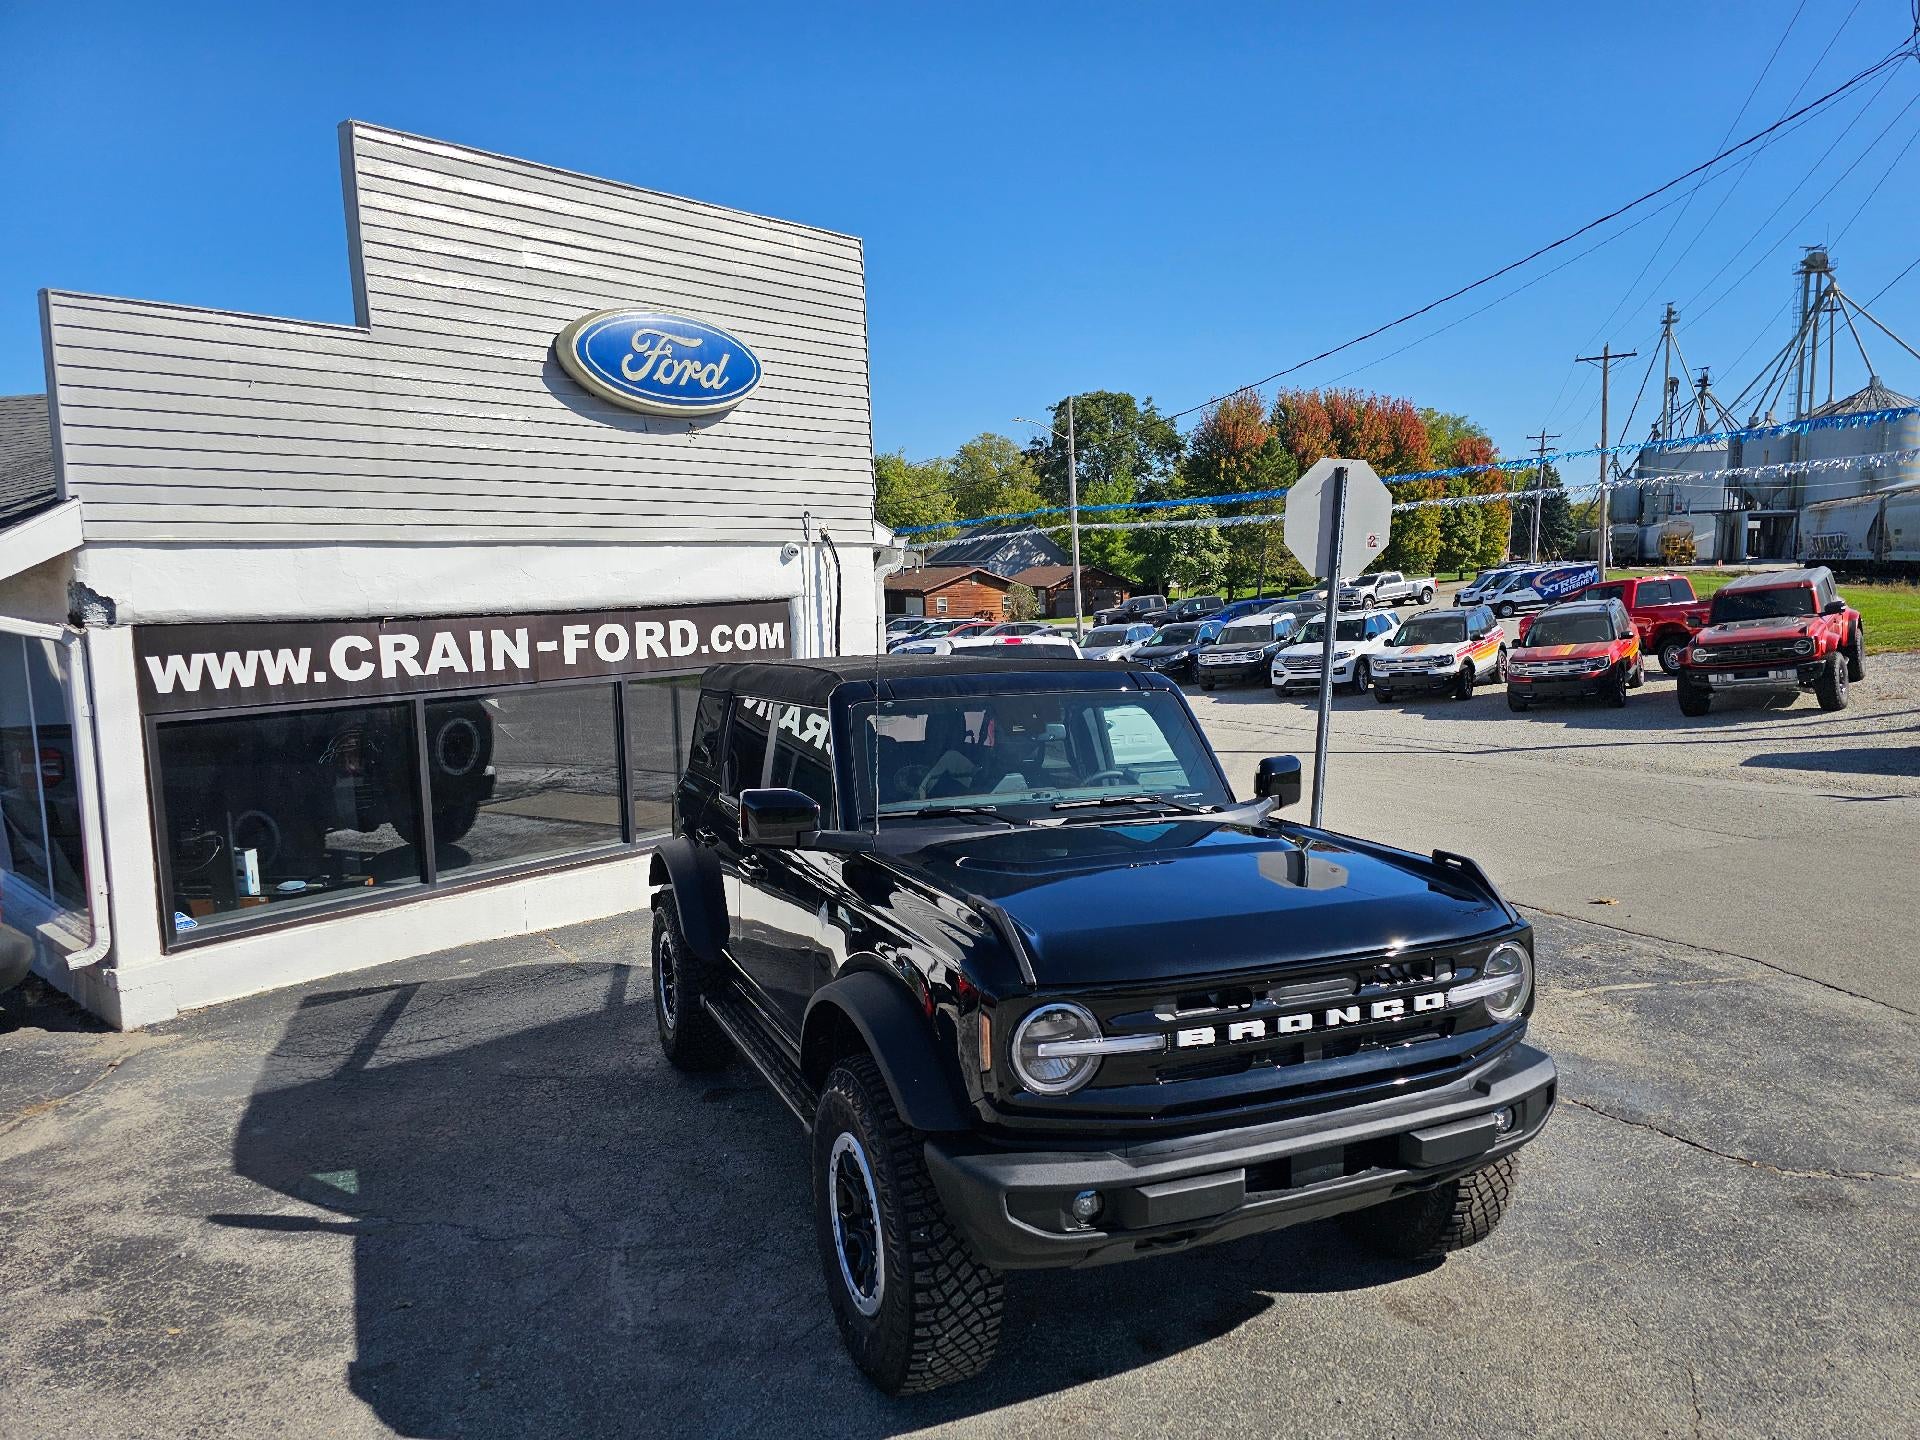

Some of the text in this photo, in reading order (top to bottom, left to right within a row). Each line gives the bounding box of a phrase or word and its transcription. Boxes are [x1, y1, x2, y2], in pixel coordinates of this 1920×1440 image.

[621, 328, 731, 390] Ford
[1543, 567, 1599, 596] XTREAM
[1560, 577, 1594, 594] INTERNET
[1176, 992, 1446, 1047] BRONCO
